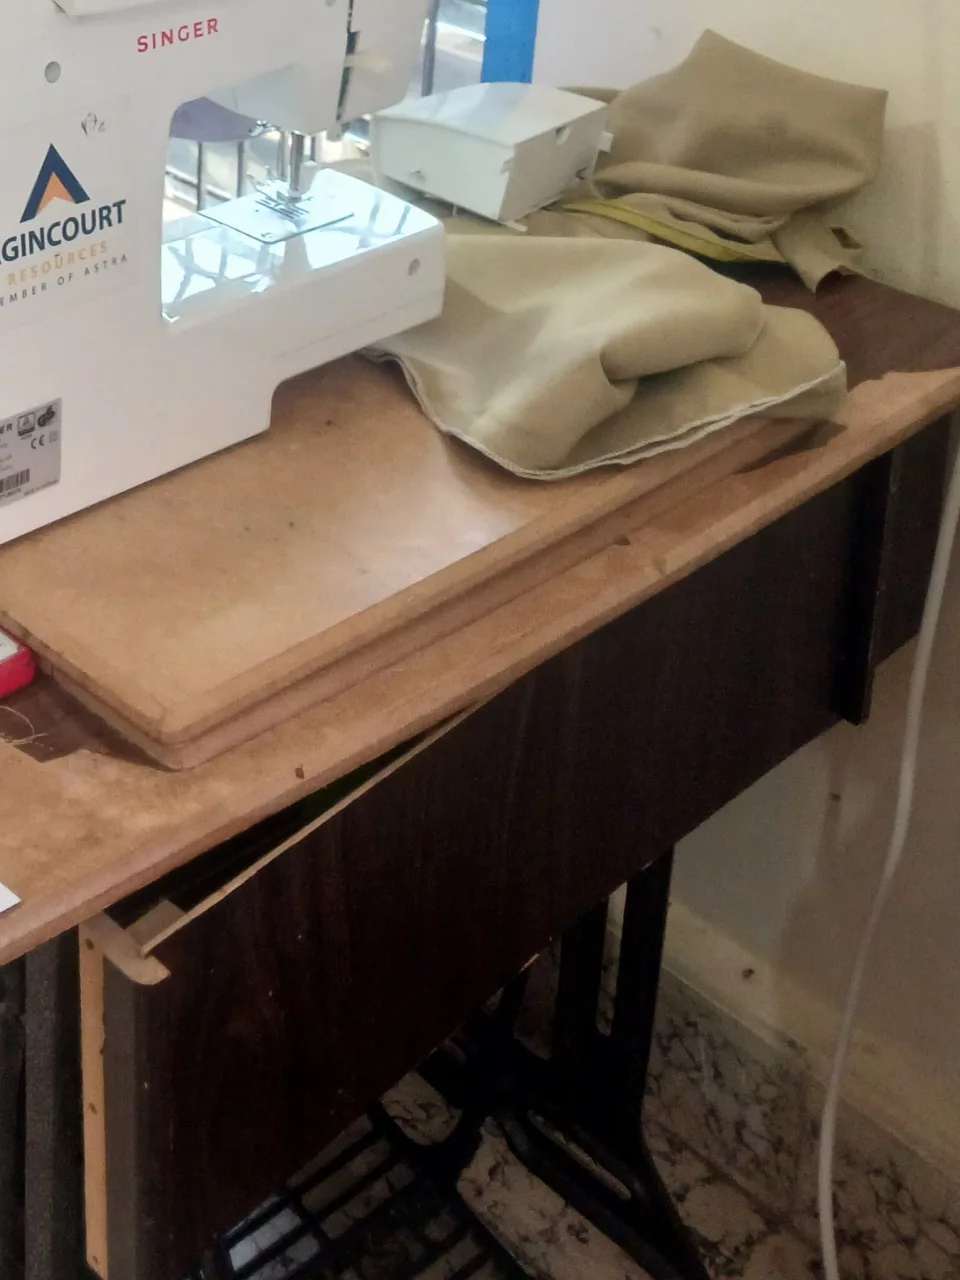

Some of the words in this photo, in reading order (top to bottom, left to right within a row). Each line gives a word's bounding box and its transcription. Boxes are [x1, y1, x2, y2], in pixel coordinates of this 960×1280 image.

[136, 17, 219, 53] SINGER
[6, 240, 108, 286] RESOURCES
[56, 272, 75, 286] OF
[83, 253, 128, 276] ASTRA
